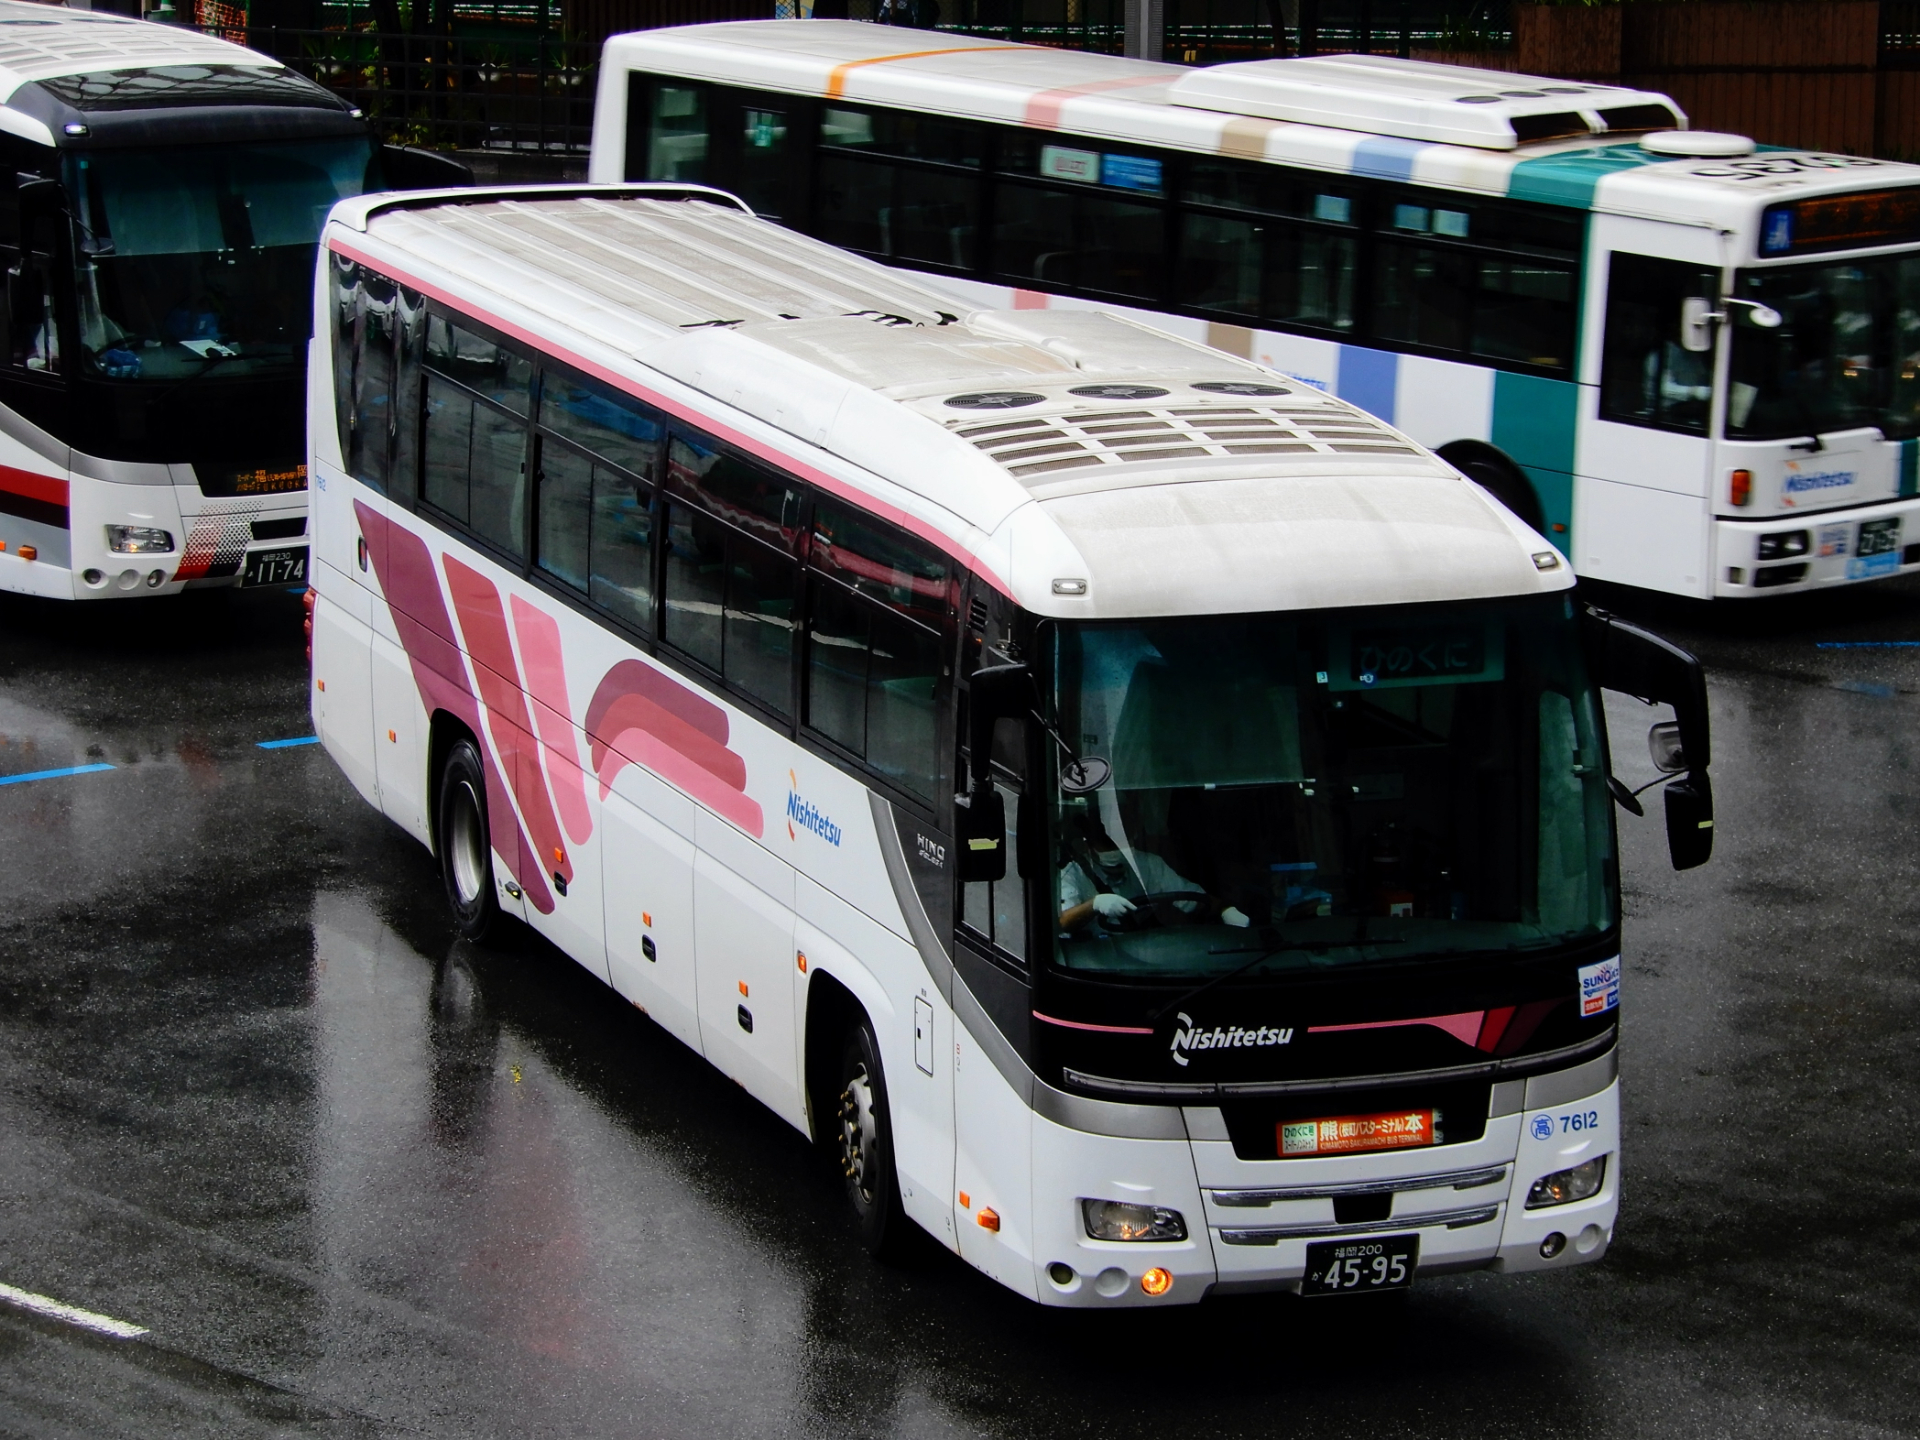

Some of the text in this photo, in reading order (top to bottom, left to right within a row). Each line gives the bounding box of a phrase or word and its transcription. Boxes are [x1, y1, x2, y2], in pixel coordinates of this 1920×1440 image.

[257, 559, 304, 583] 11-74
[1361, 643, 1468, 672] ひのくに
[786, 789, 842, 848] Nishitetsu
[917, 833, 946, 861] HINO
[1170, 1026, 1294, 1051] Nishitetsu
[1559, 1110, 1599, 1134] 7612
[1320, 1140, 1350, 1151] KUMAMOTO
[1387, 1136, 1398, 1146] BUS
[1398, 1133, 1424, 1145] TERMINAL
[1324, 1254, 1408, 1289] 45-95
